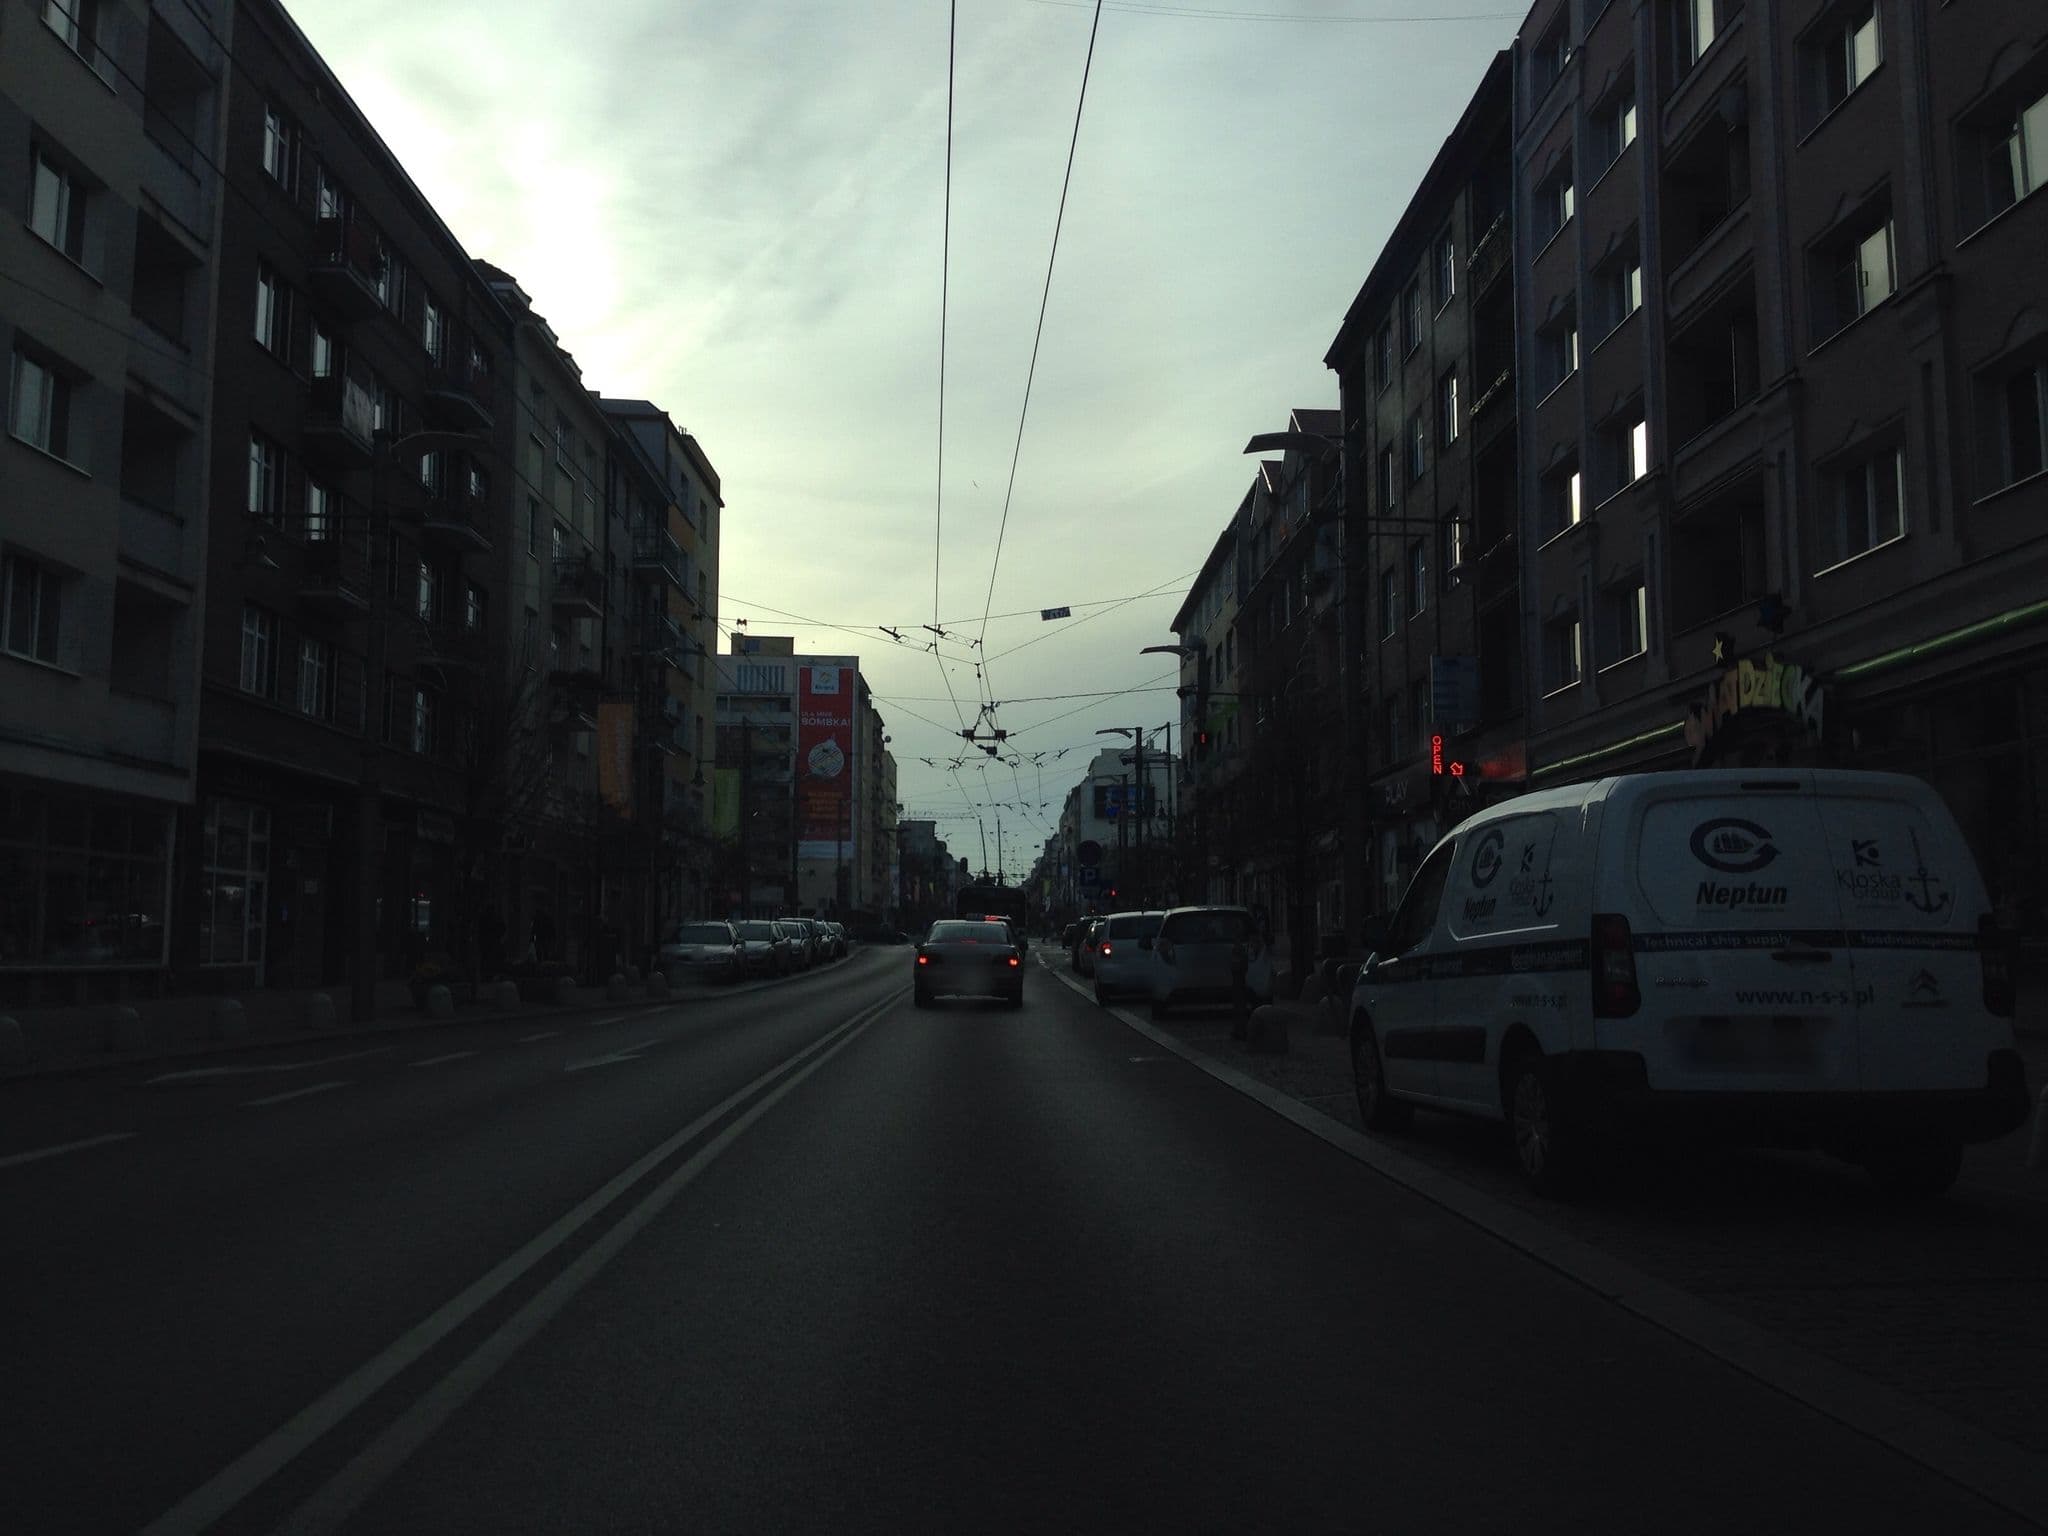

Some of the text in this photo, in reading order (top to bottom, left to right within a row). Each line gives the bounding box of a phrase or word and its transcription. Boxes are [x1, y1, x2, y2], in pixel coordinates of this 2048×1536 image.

[1431, 735, 1443, 775] OPEN
[1835, 868, 1901, 891] Kloska
[1696, 881, 1788, 911] Neptun
[1852, 887, 1902, 900] Group
[1462, 895, 1497, 924] Neptun
[1647, 934, 1708, 947] Technical
[1711, 934, 1741, 948] ship
[1744, 933, 1792, 947] supply
[1735, 986, 1875, 1008] www.n-s-s.pl
